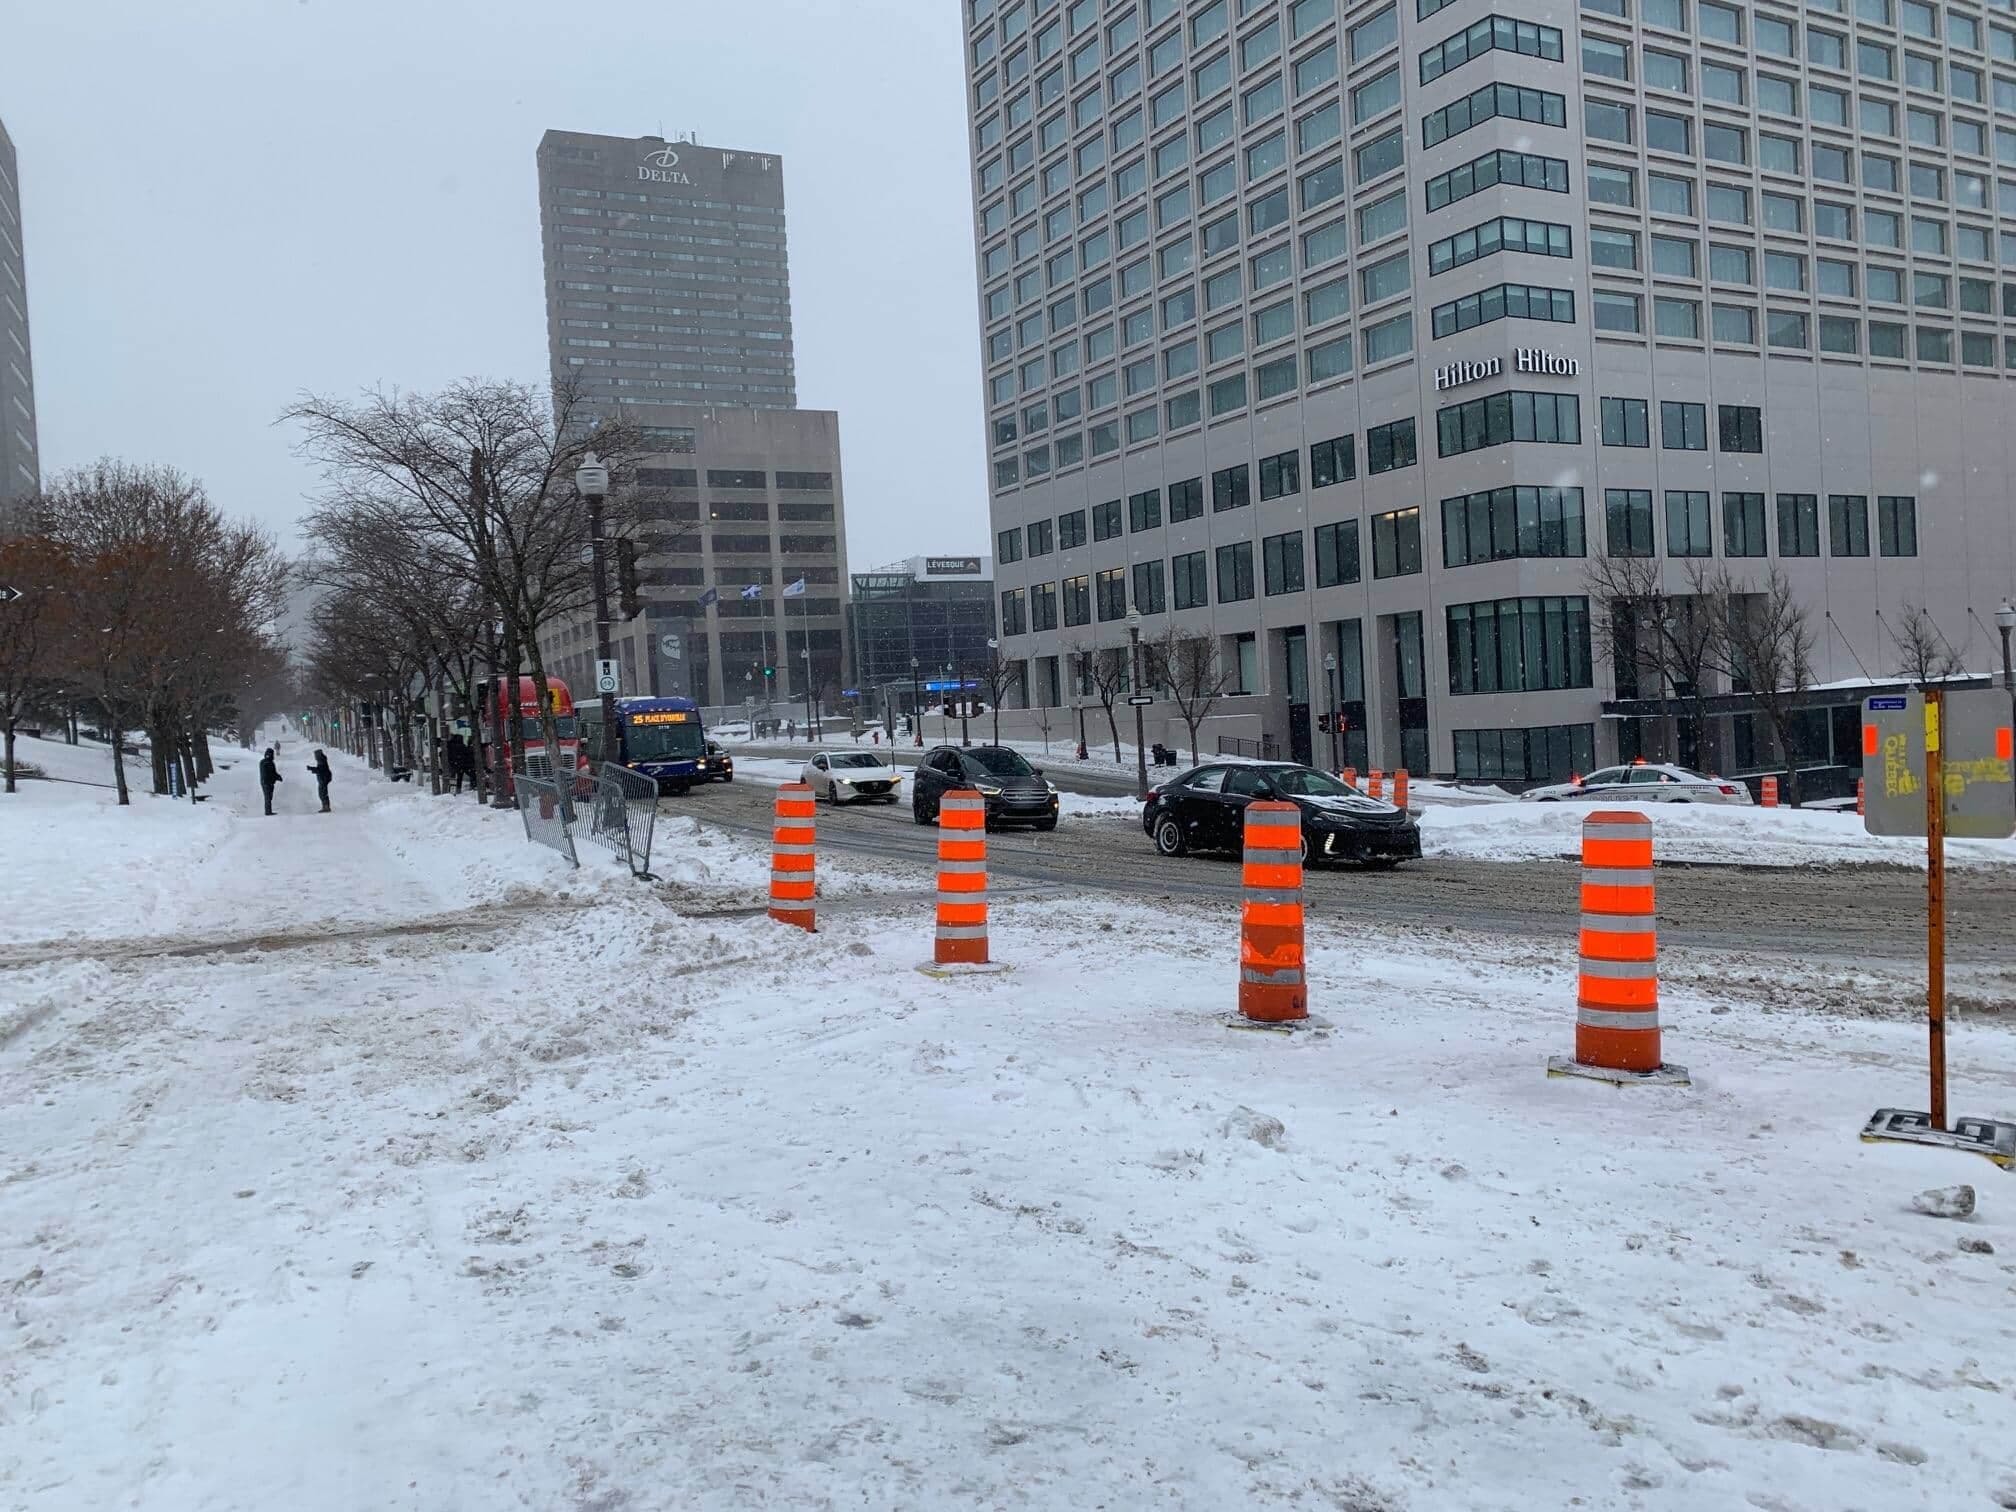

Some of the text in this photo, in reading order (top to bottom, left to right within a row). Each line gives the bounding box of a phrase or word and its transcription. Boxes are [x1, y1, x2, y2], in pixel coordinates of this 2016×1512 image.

[638, 166, 690, 185] DELTA
[1434, 356, 1501, 390] Hilton
[1516, 348, 1579, 375] Hilton
